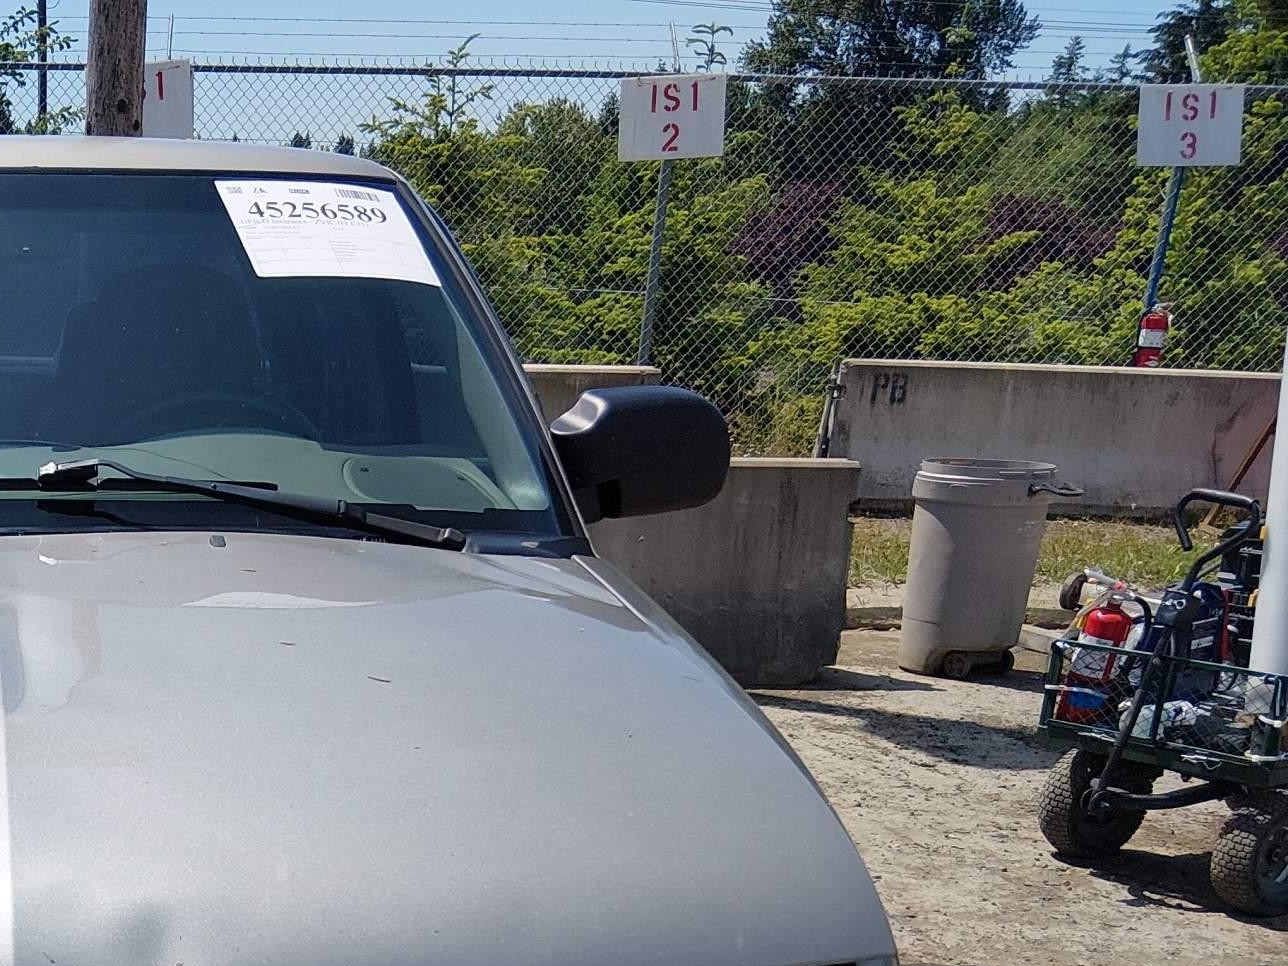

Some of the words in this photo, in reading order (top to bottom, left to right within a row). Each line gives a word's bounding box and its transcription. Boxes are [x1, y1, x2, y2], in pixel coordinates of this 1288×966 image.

[661, 122, 681, 152] 2
[1179, 131, 1198, 160] 3
[248, 201, 388, 224] 45256589
[871, 373, 909, 404] PB
